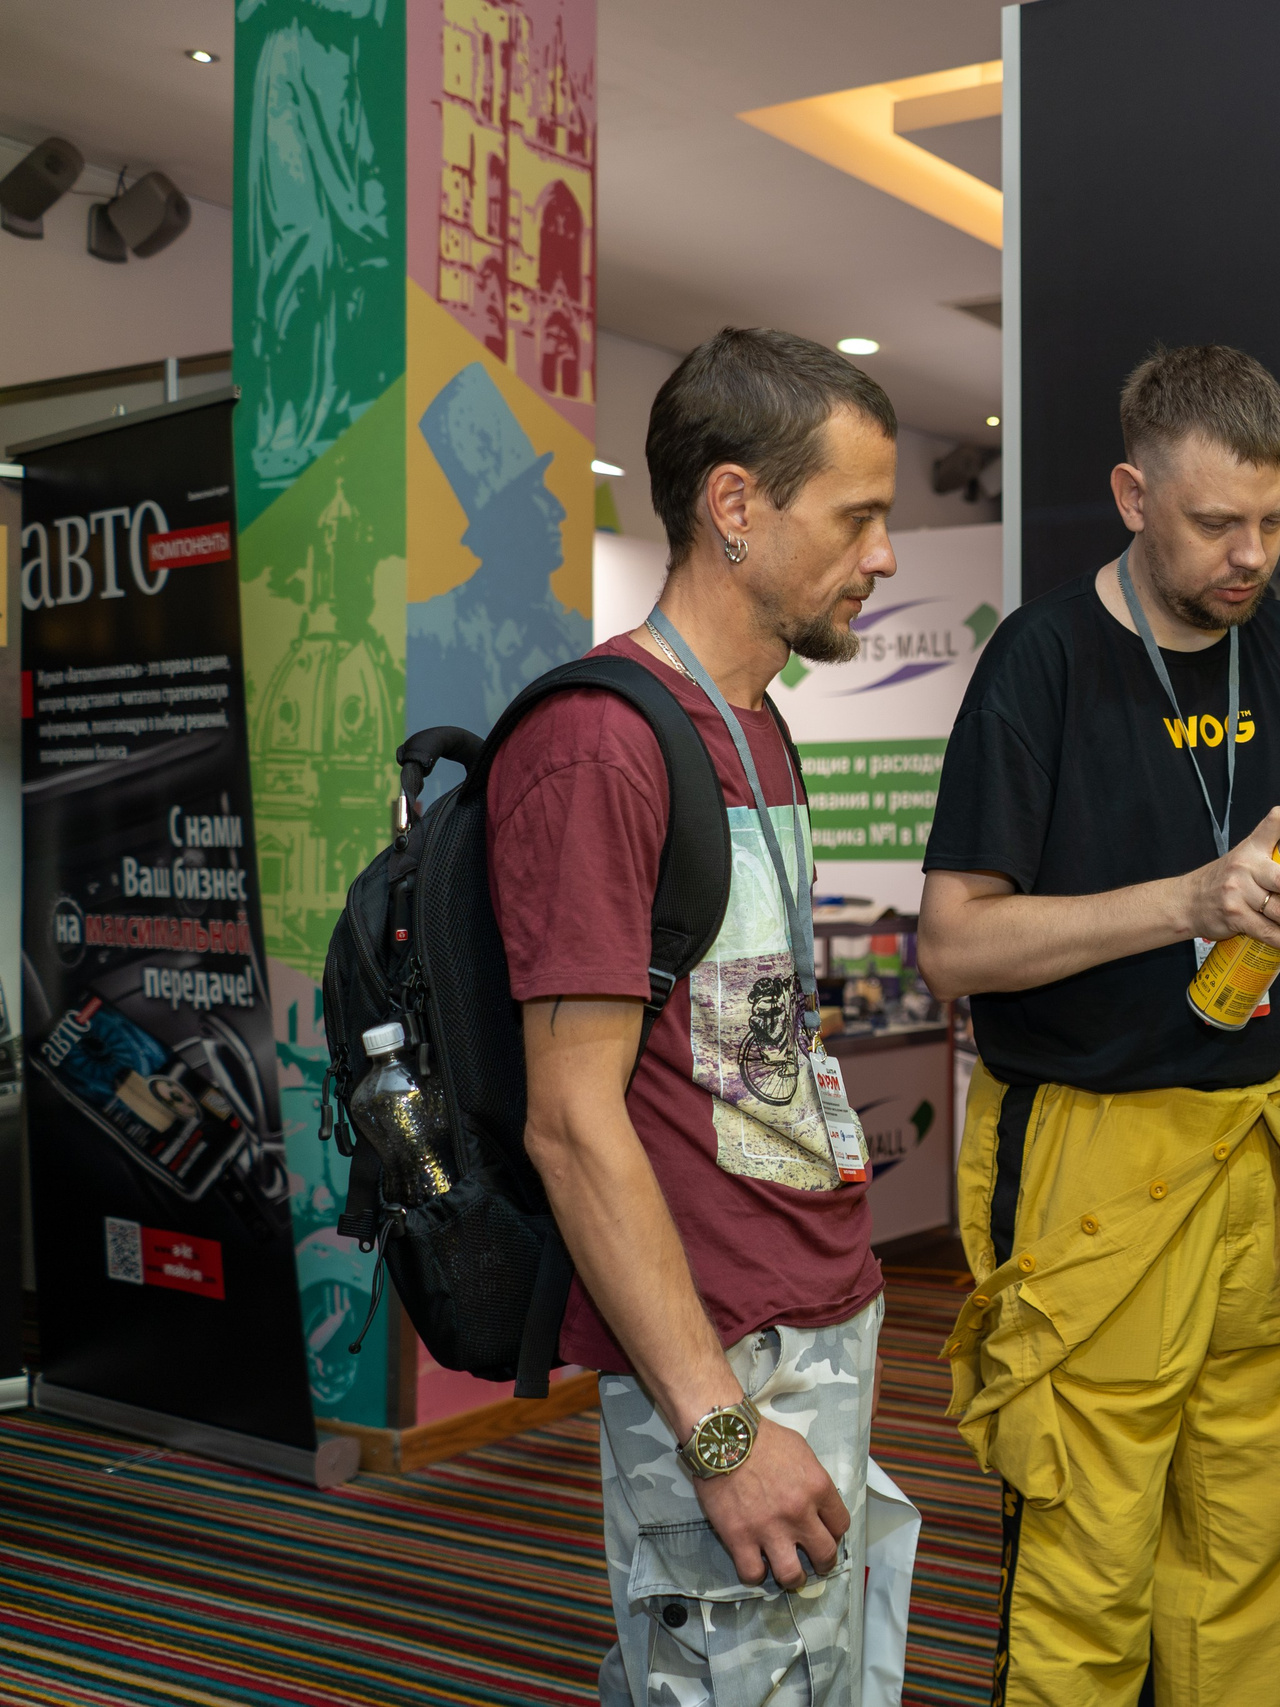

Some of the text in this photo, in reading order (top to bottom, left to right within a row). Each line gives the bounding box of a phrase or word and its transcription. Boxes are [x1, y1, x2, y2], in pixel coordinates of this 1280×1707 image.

[857, 631, 958, 662] TS-MALL
[1163, 714, 1255, 748] WOG
[169, 805, 243, 848] С нами
[122, 856, 247, 900] Ваш бизнес
[56, 909, 251, 956] на максимальной
[143, 965, 255, 1011] передаче!
